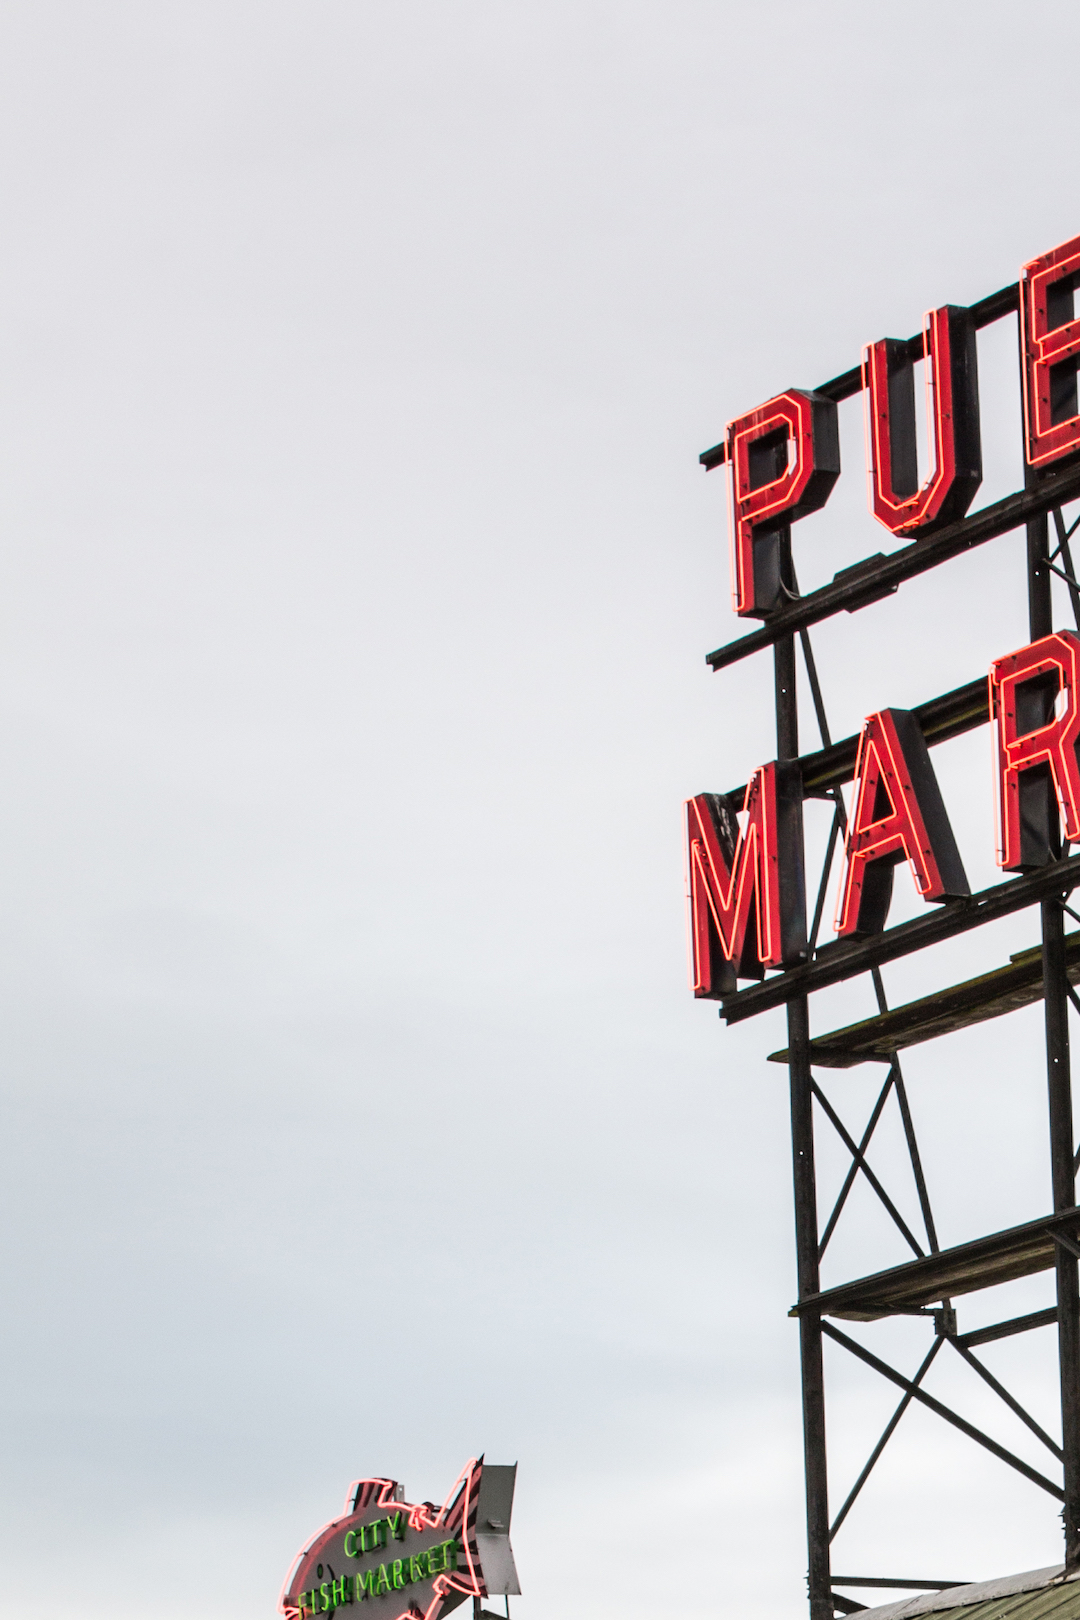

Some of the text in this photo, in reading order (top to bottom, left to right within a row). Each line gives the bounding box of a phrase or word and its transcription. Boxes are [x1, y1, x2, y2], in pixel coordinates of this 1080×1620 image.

[344, 1511, 408, 1559] CITY
[297, 1539, 459, 1620] FISH MARKET
